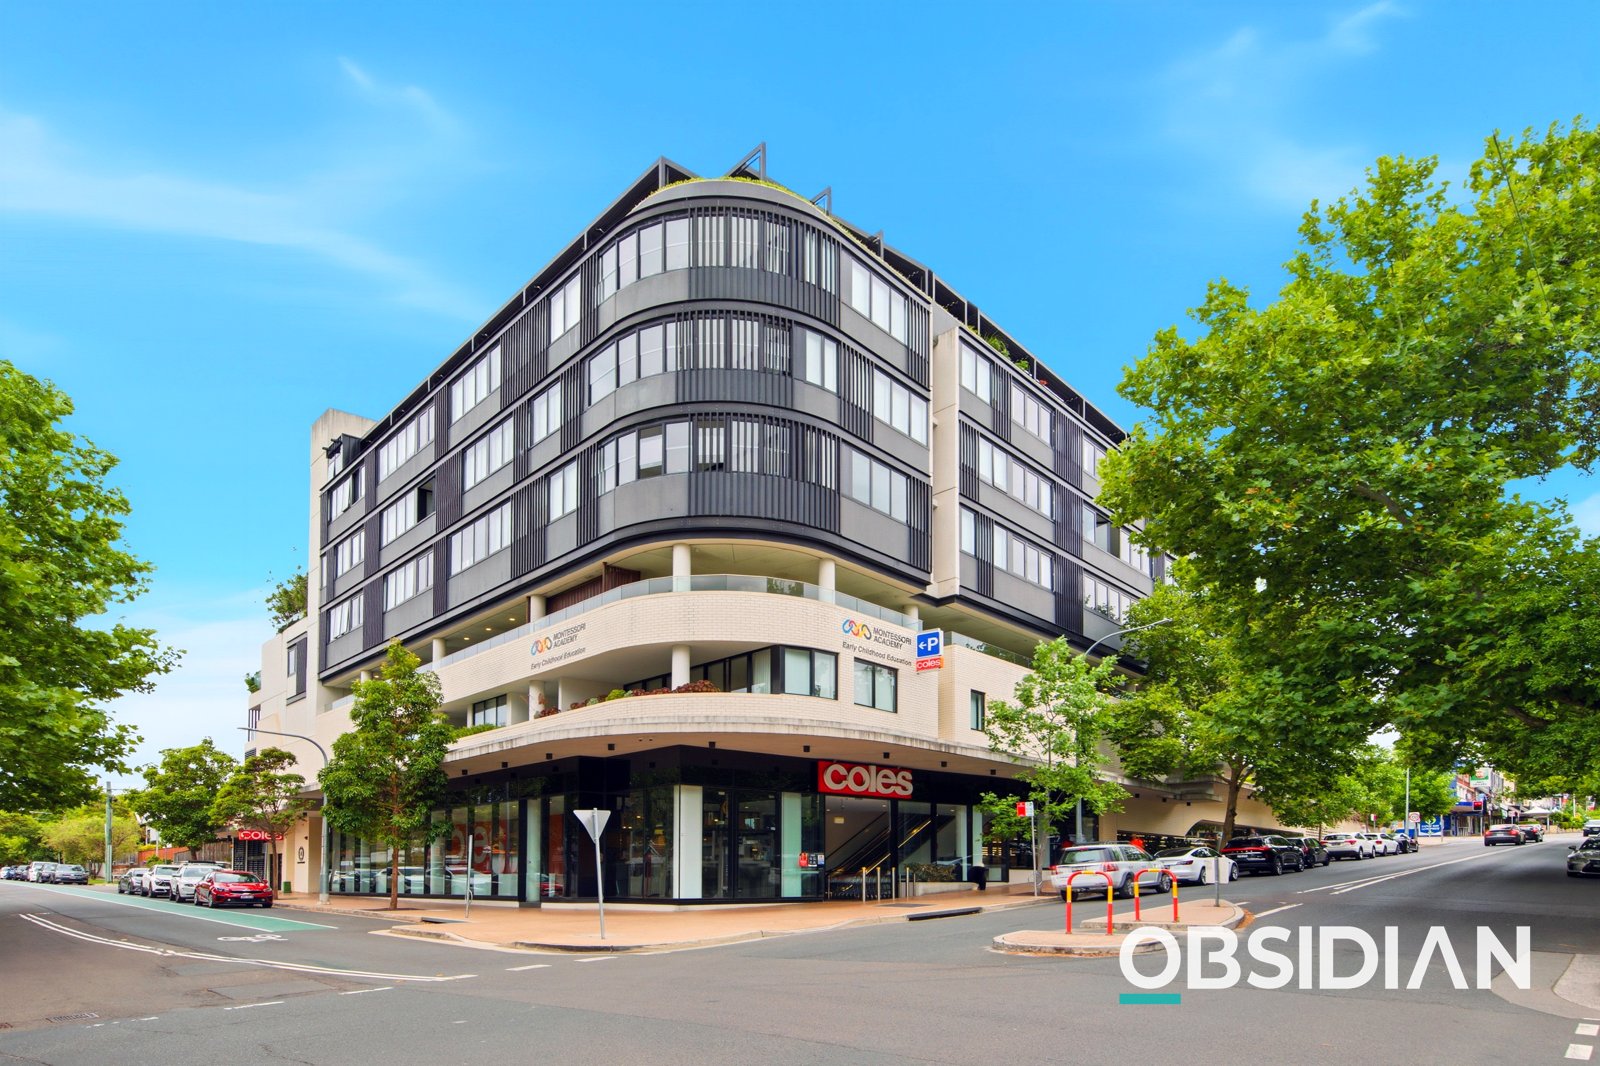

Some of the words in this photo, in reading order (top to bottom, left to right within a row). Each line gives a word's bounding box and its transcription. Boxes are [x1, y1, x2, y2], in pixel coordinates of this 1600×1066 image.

[553, 623, 586, 640] MONTESSORI
[873, 627, 912, 645] MONTESSORI
[553, 634, 578, 648] ACADEMY
[873, 636, 902, 650] ACADEMY
[927, 637, 938, 651] P
[842, 641, 857, 652] Early
[858, 646, 885, 660] Childhood
[887, 654, 912, 666] Education
[917, 659, 941, 669] coles
[823, 764, 913, 796] coles
